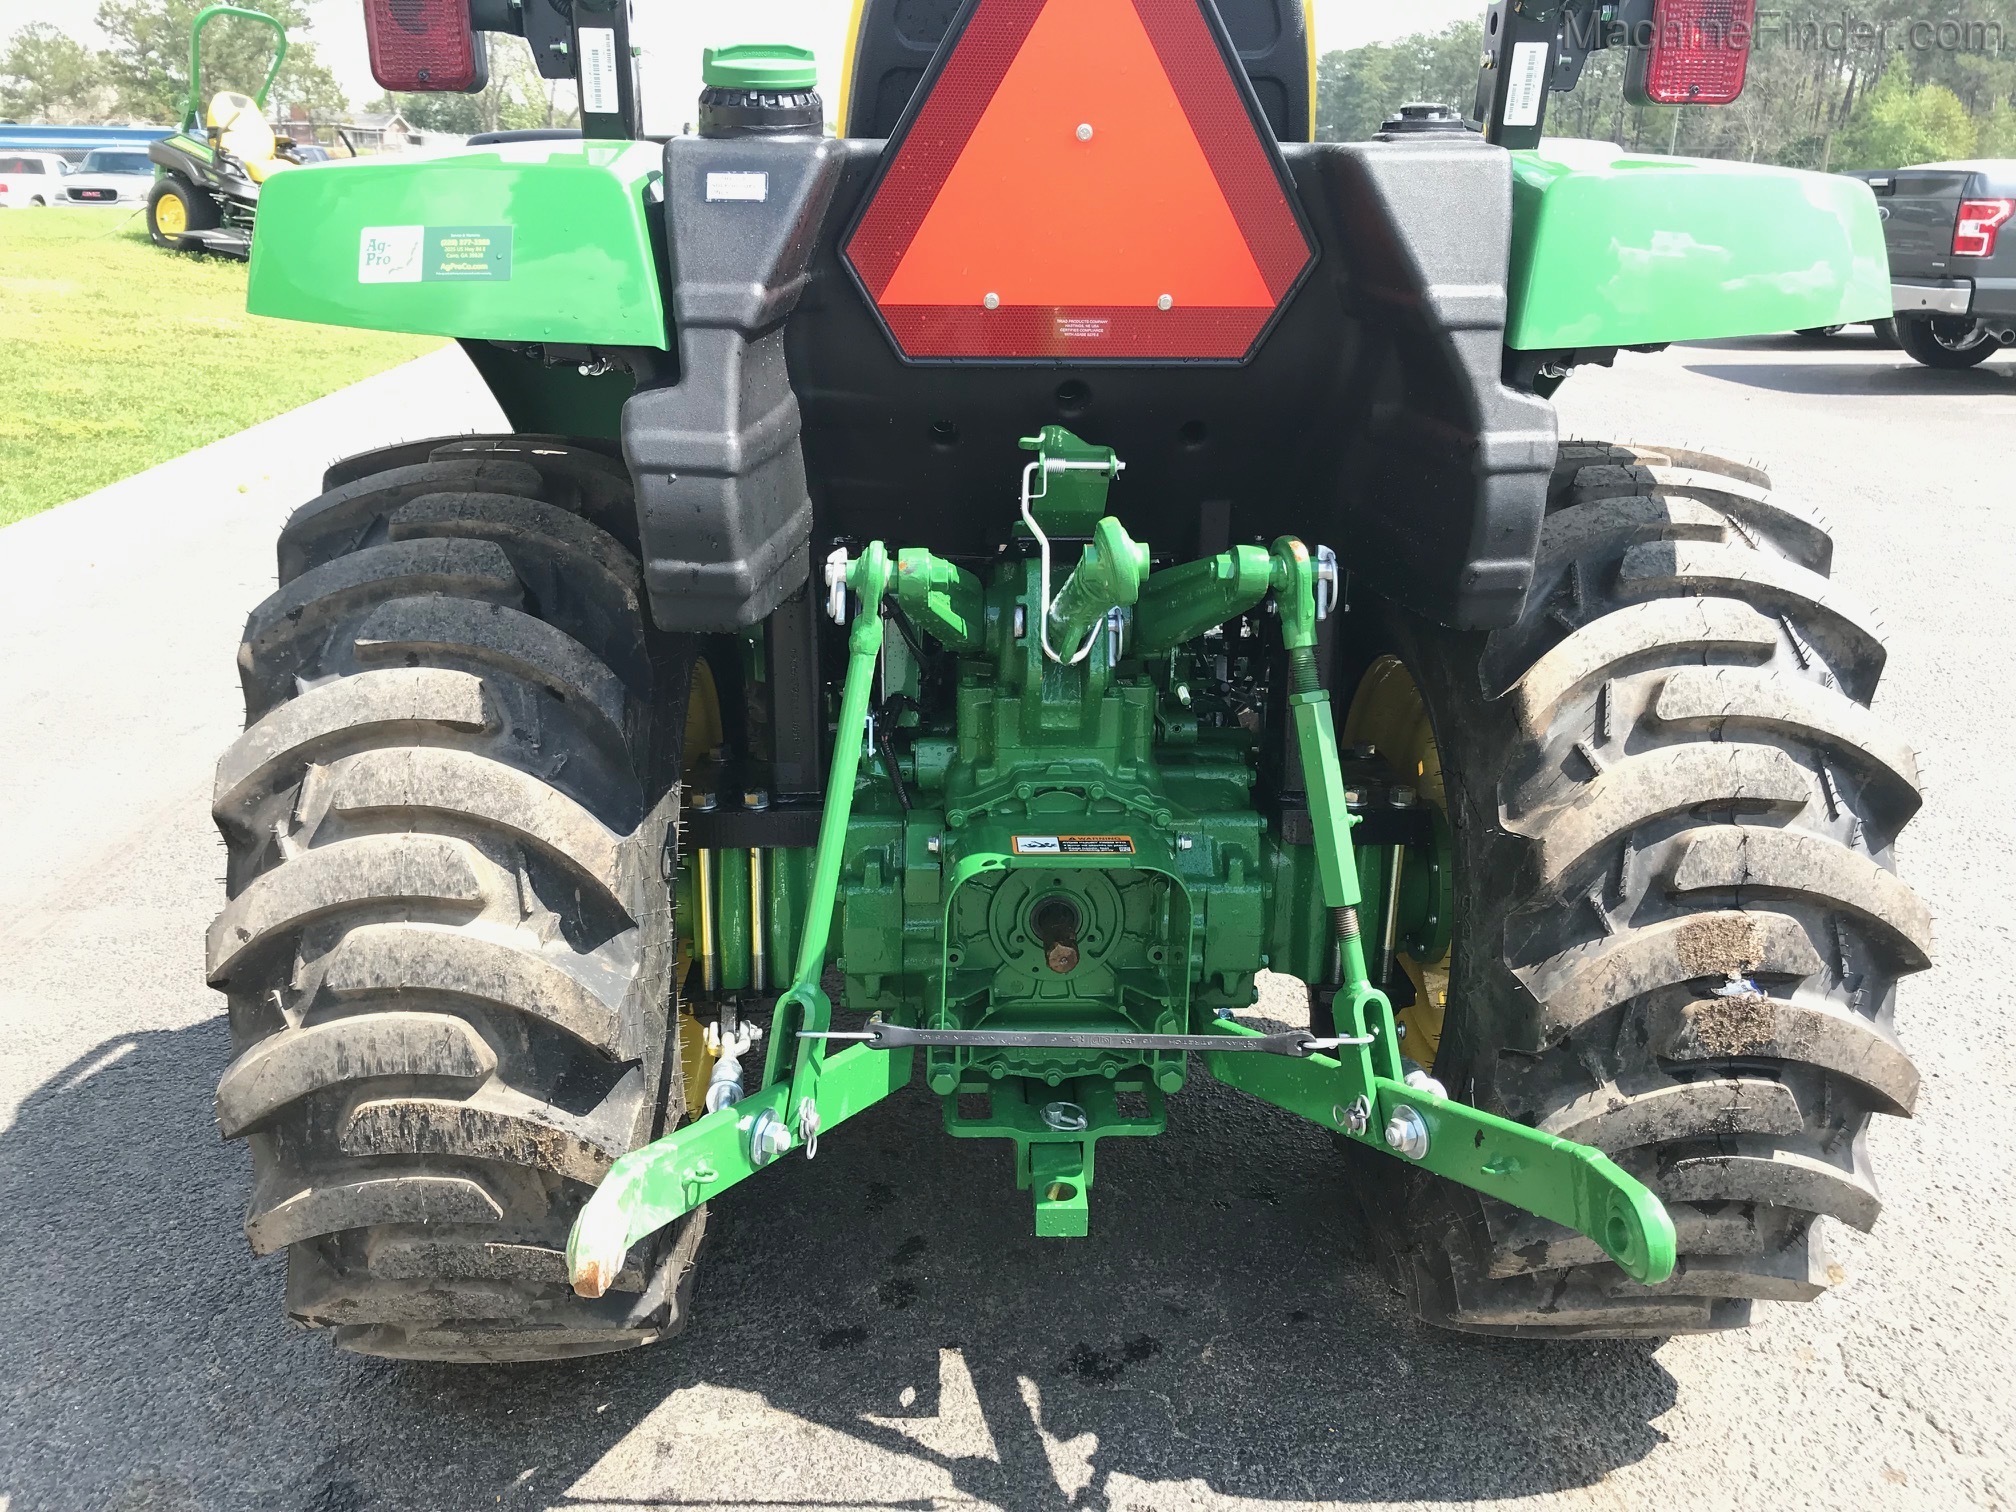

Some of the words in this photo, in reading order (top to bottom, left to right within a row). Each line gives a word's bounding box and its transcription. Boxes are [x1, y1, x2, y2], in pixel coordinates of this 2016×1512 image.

[366, 239, 391, 254] Ag-
[365, 253, 391, 266] Pro
[440, 262, 488, 271] AgProCo.com
